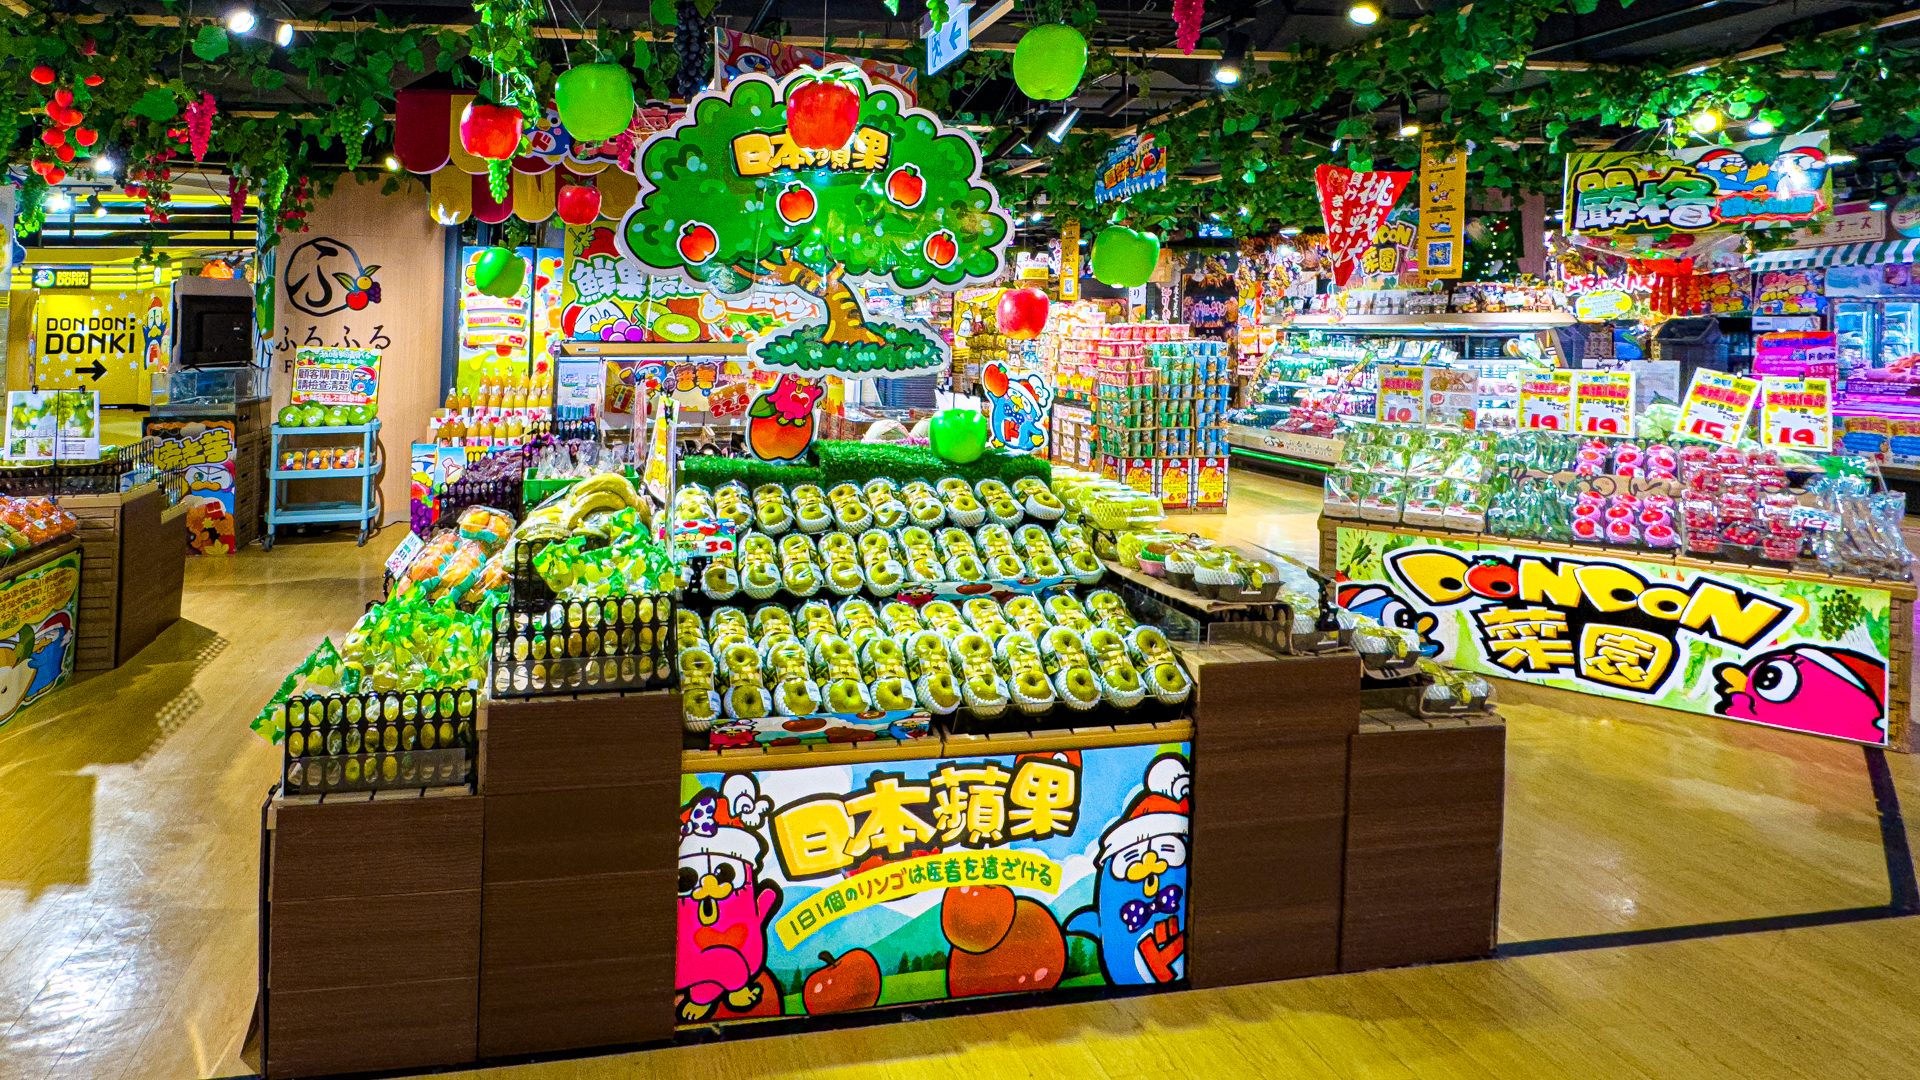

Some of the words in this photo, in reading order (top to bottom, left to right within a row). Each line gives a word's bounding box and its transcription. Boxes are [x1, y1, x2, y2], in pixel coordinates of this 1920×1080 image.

[45, 333, 135, 355] DONKI
[275, 324, 391, 351] ふるふる
[1530, 413, 1558, 430] 19
[1587, 416, 1617, 433] 19
[1691, 419, 1726, 441] 15
[1779, 427, 1816, 445] 19
[1396, 557, 1783, 645] DONDON
[1485, 605, 1673, 692] 菜園
[774, 761, 1077, 876] 日本蘋果
